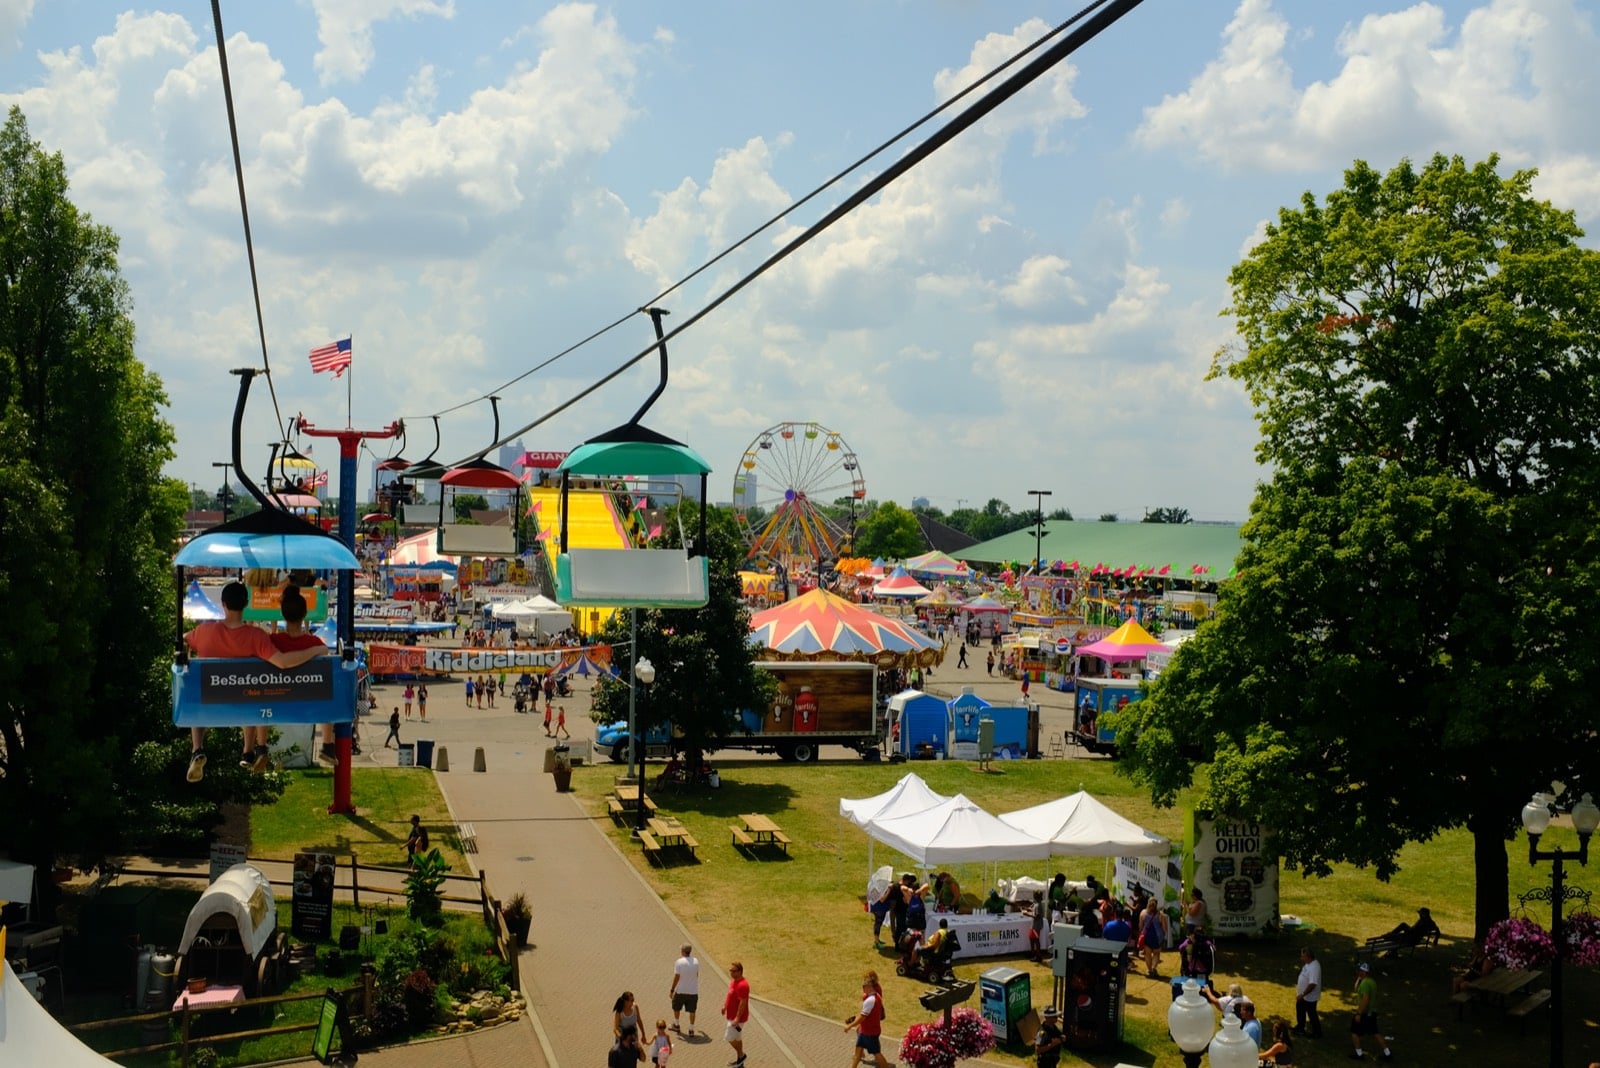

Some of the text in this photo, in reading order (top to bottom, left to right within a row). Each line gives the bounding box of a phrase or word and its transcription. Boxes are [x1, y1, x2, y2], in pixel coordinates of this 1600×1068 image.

[1087, 631, 1108, 642] GYR
[372, 649, 562, 672] meijer Kiddieland
[210, 673, 323, 686] BeSafeOhio.com
[774, 694, 793, 705] rlife
[260, 709, 273, 718] 75
[1216, 837, 1260, 853] OHIO!
[1145, 862, 1161, 882] FARMS
[967, 929, 1020, 942] BRIGHT FARMS
